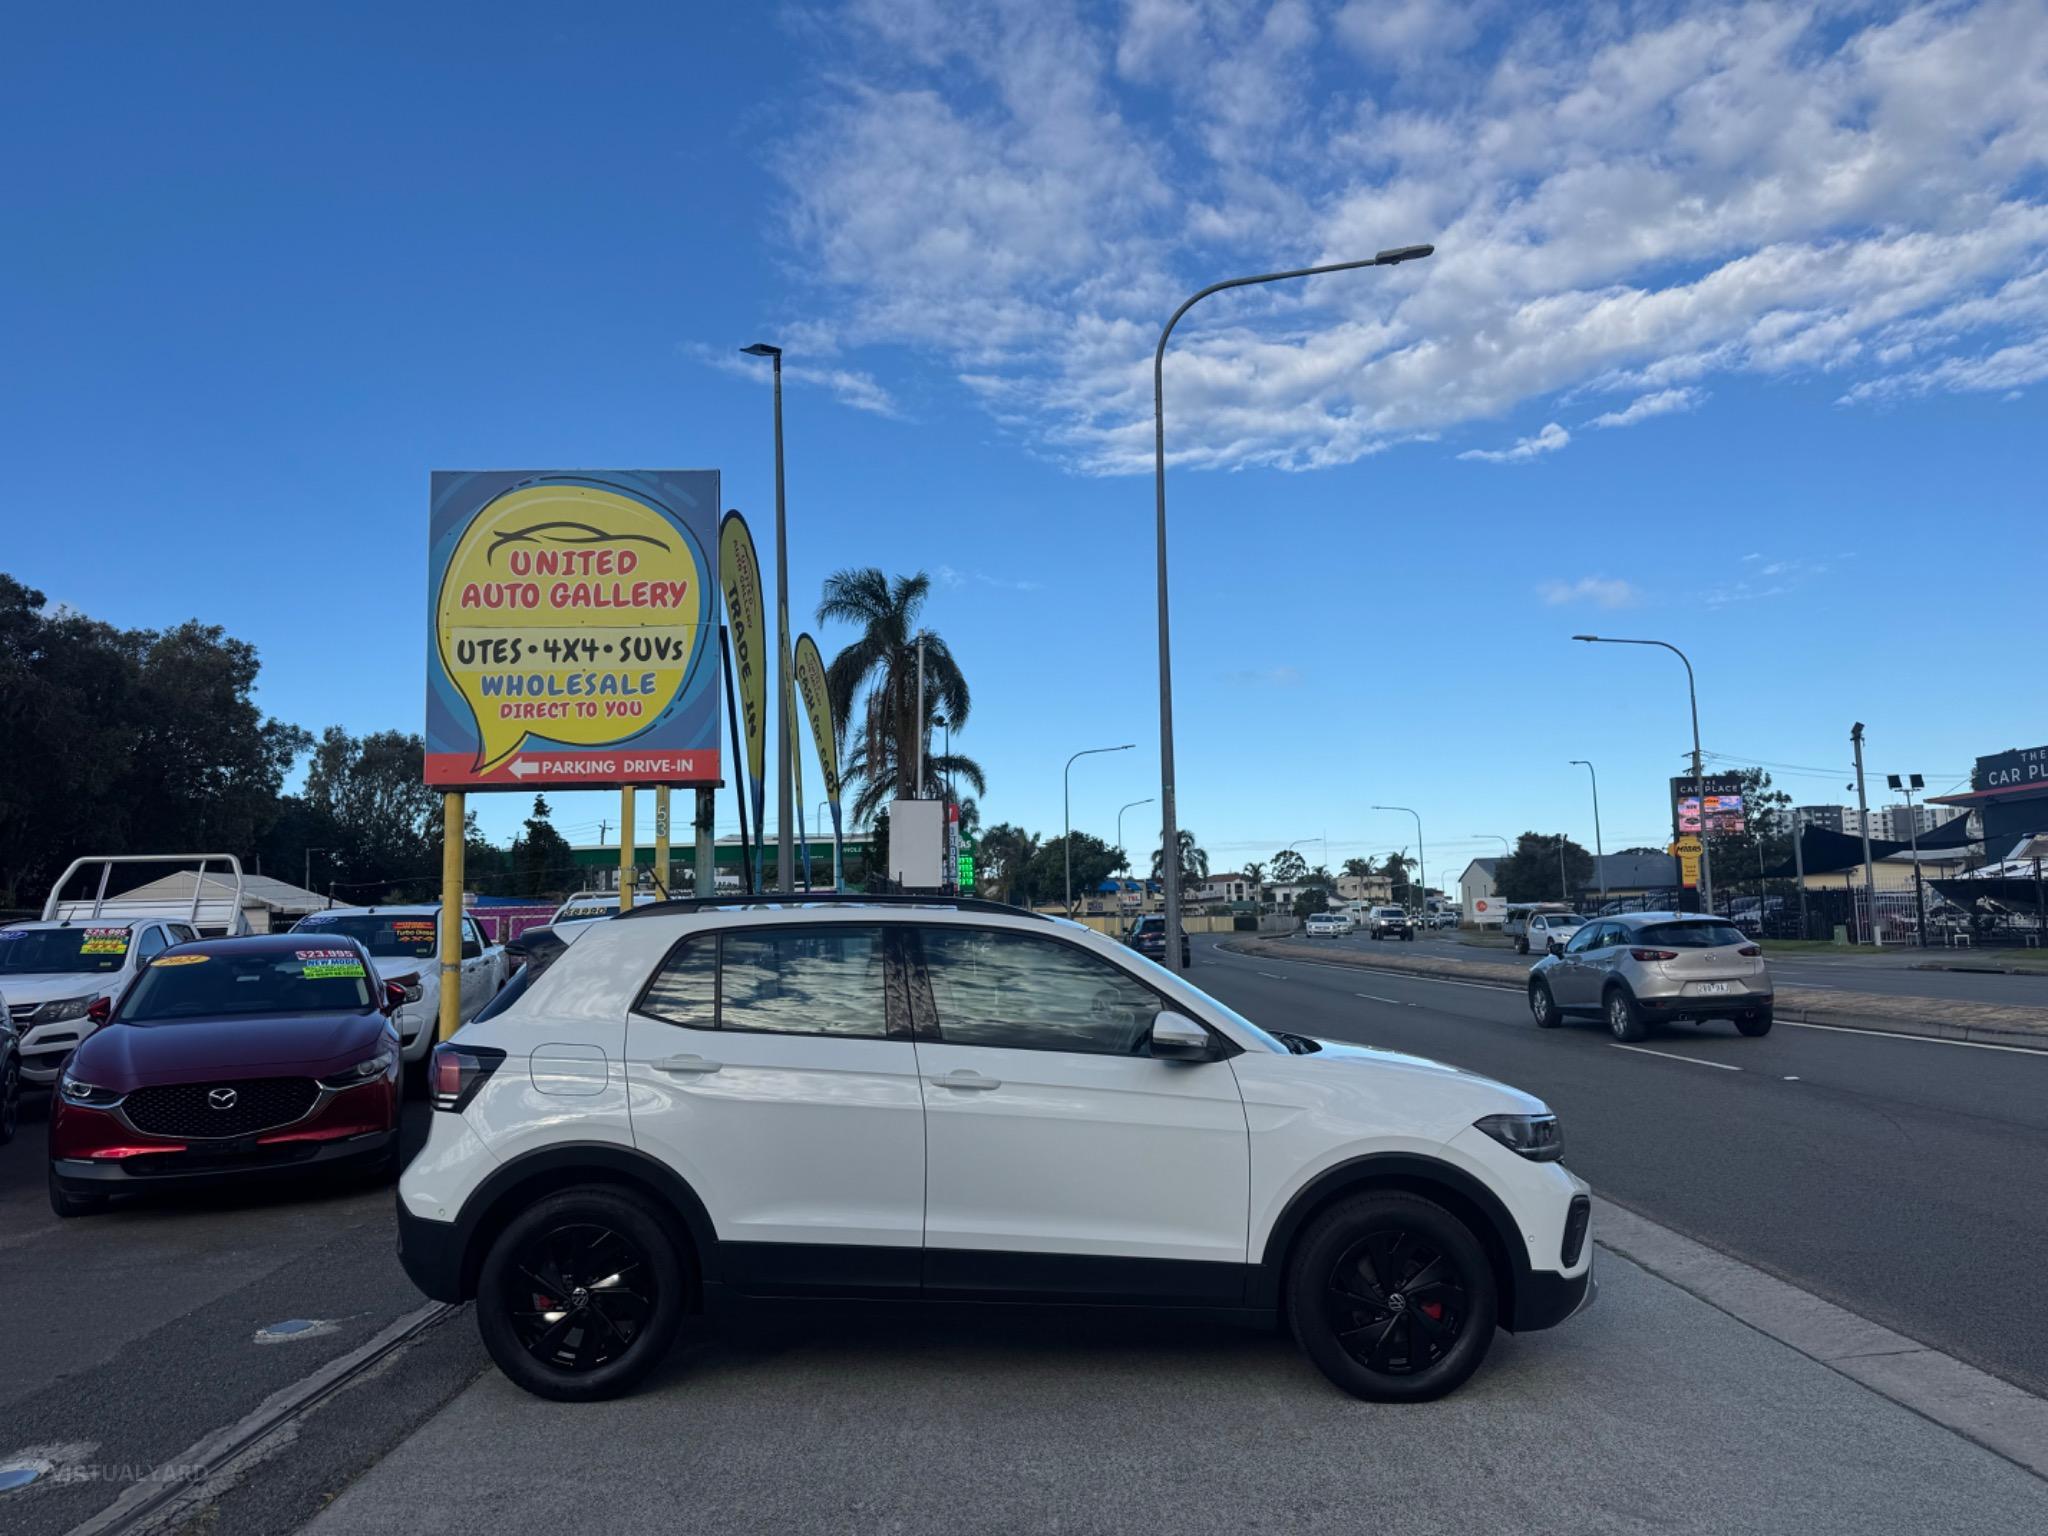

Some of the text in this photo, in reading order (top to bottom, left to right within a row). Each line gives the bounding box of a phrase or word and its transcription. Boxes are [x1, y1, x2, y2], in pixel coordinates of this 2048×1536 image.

[510, 550, 638, 576] UNITED
[461, 581, 687, 609] AUTO GALLERY
[457, 636, 683, 665] UTES 4X4 SUVs
[481, 672, 656, 697] WHOLESALE
[500, 700, 643, 719] DIRECT TO YOU
[2020, 750, 2047, 762] THE
[542, 758, 693, 775] PARKING DRIVE-IN
[1988, 768, 2021, 785] CAR
[1704, 785, 1738, 793] PLACE
